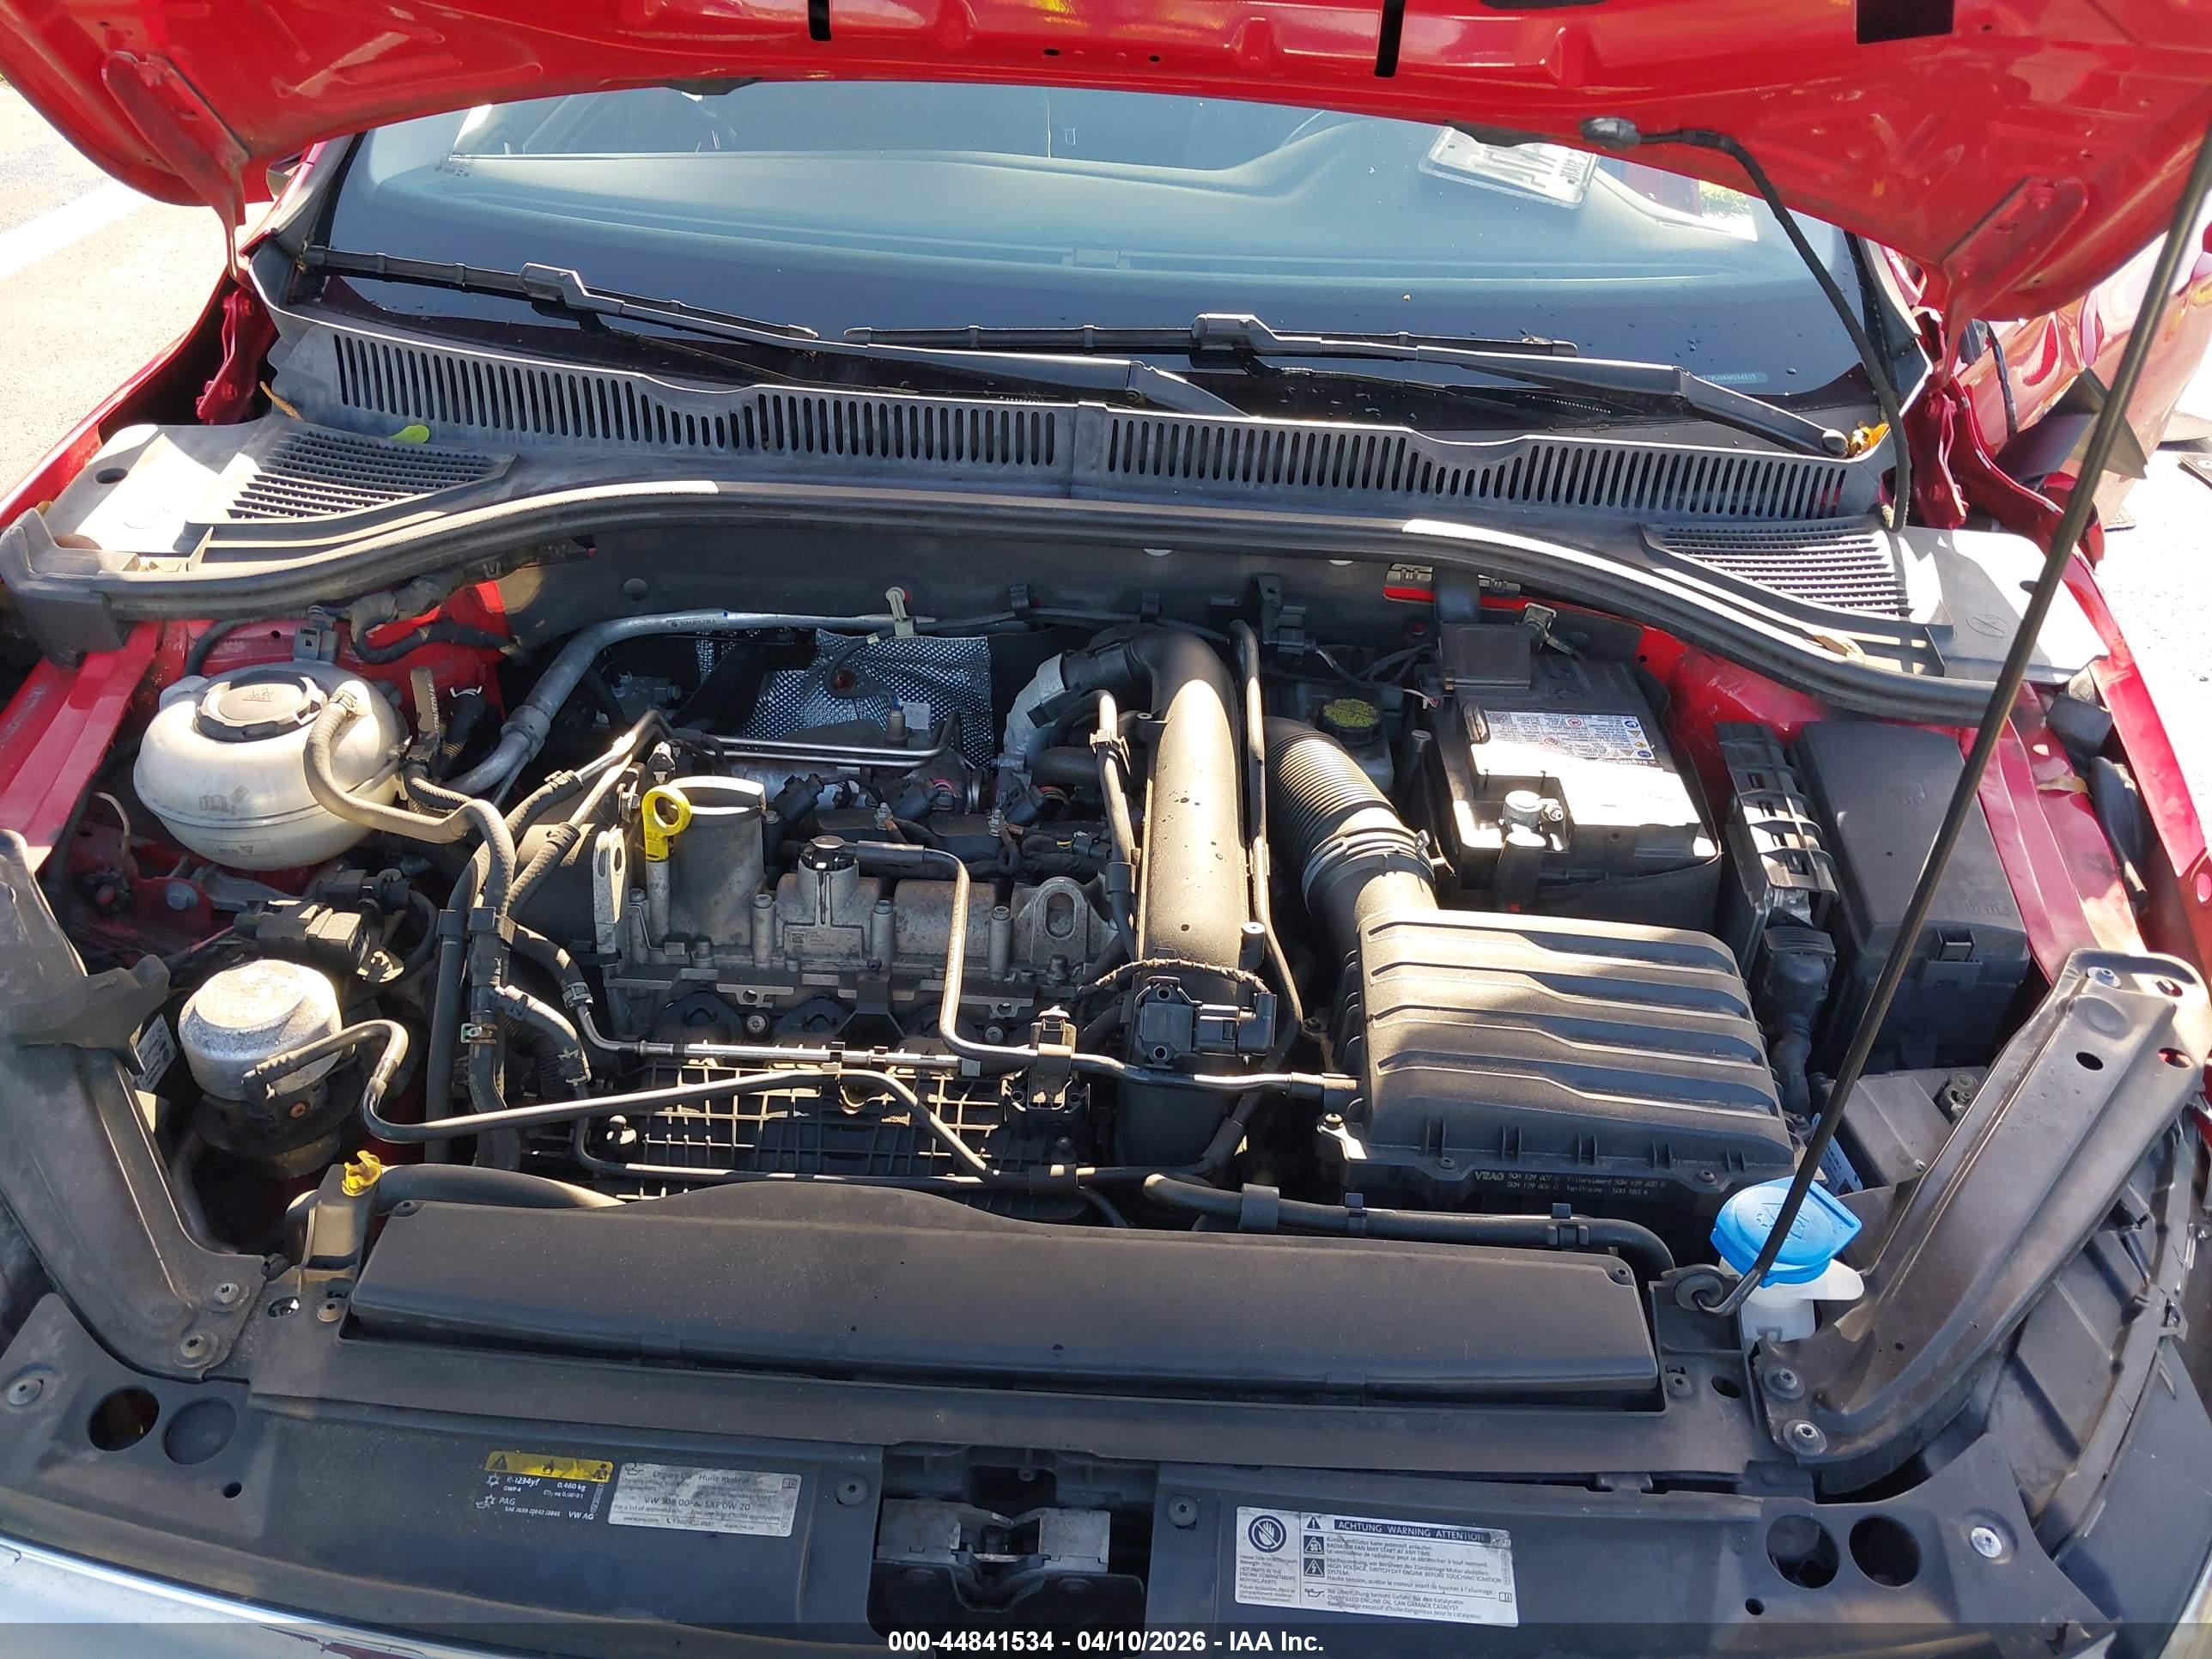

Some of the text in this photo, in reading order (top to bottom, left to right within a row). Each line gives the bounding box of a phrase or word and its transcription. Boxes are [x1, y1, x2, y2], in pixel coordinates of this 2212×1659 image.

[577, 1484, 586, 1492] kg
[499, 1497, 515, 1505] PAG
[568, 1510, 581, 1519] VW
[1338, 1520, 1382, 1532] ACHTUNG
[1387, 1525, 1431, 1537] WARNING
